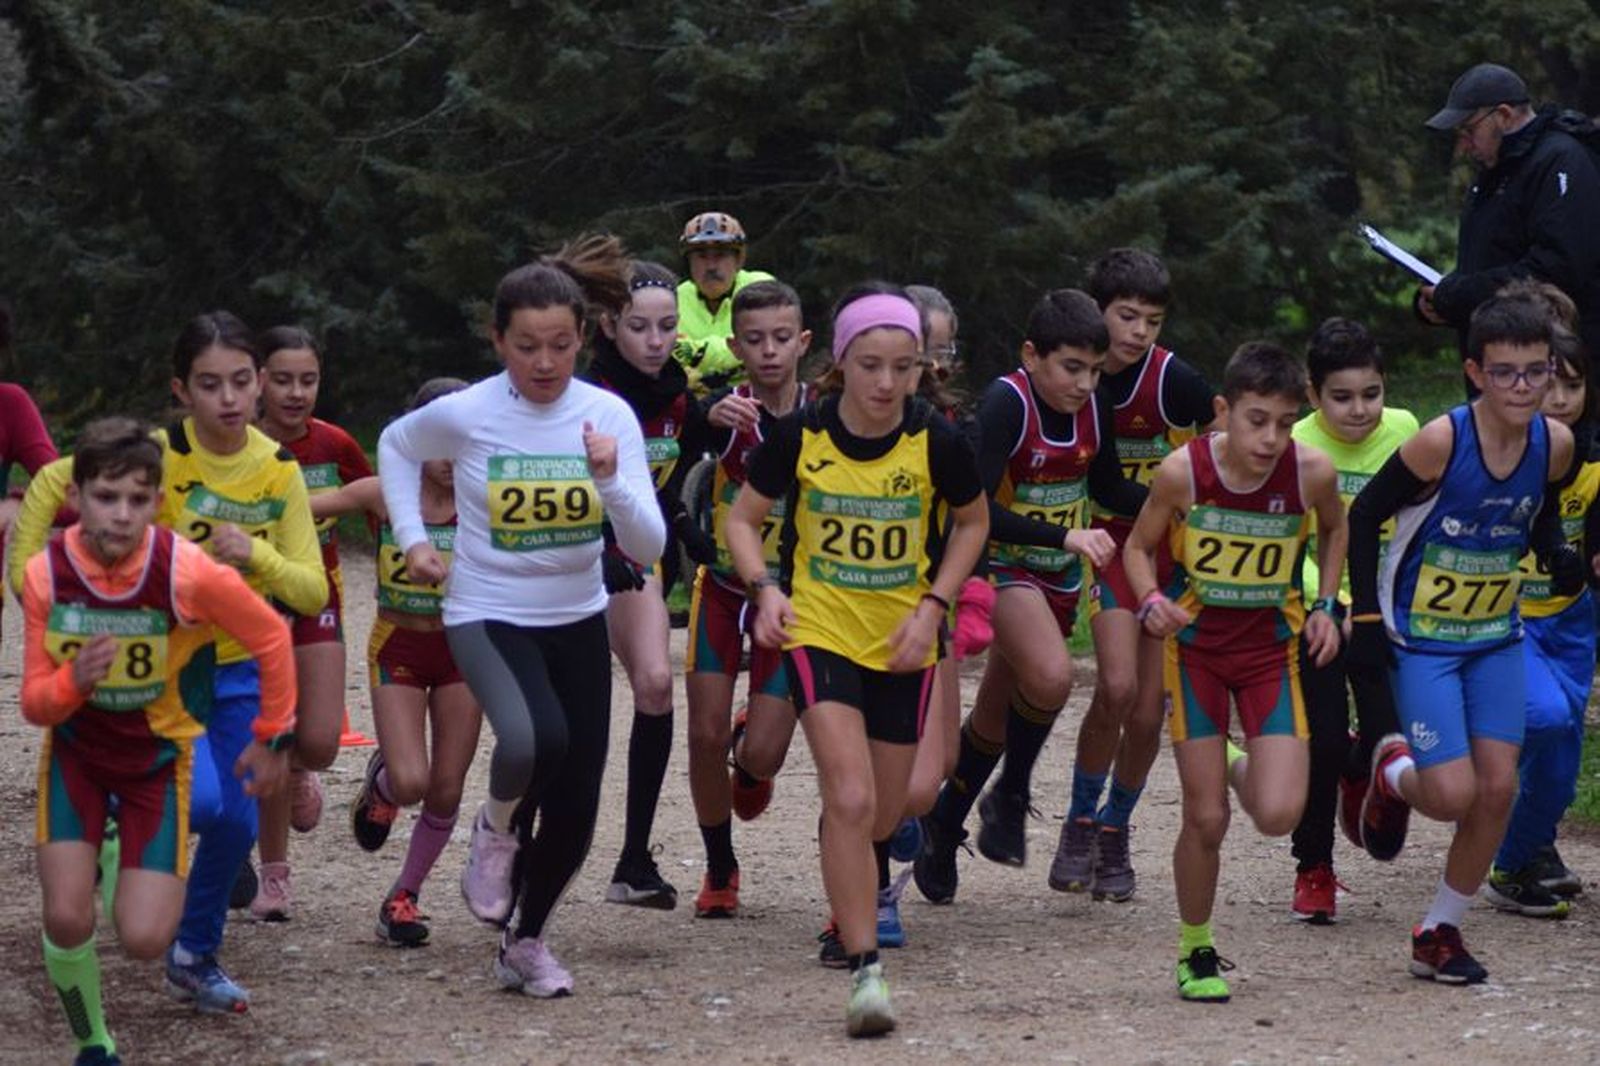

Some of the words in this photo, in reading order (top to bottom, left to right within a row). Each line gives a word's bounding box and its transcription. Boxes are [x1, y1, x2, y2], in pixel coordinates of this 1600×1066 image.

[501, 486, 590, 524] 259
[821, 518, 908, 562] 260
[1194, 536, 1283, 578] 270
[838, 570, 868, 585] CAJA
[1427, 575, 1512, 617] 277
